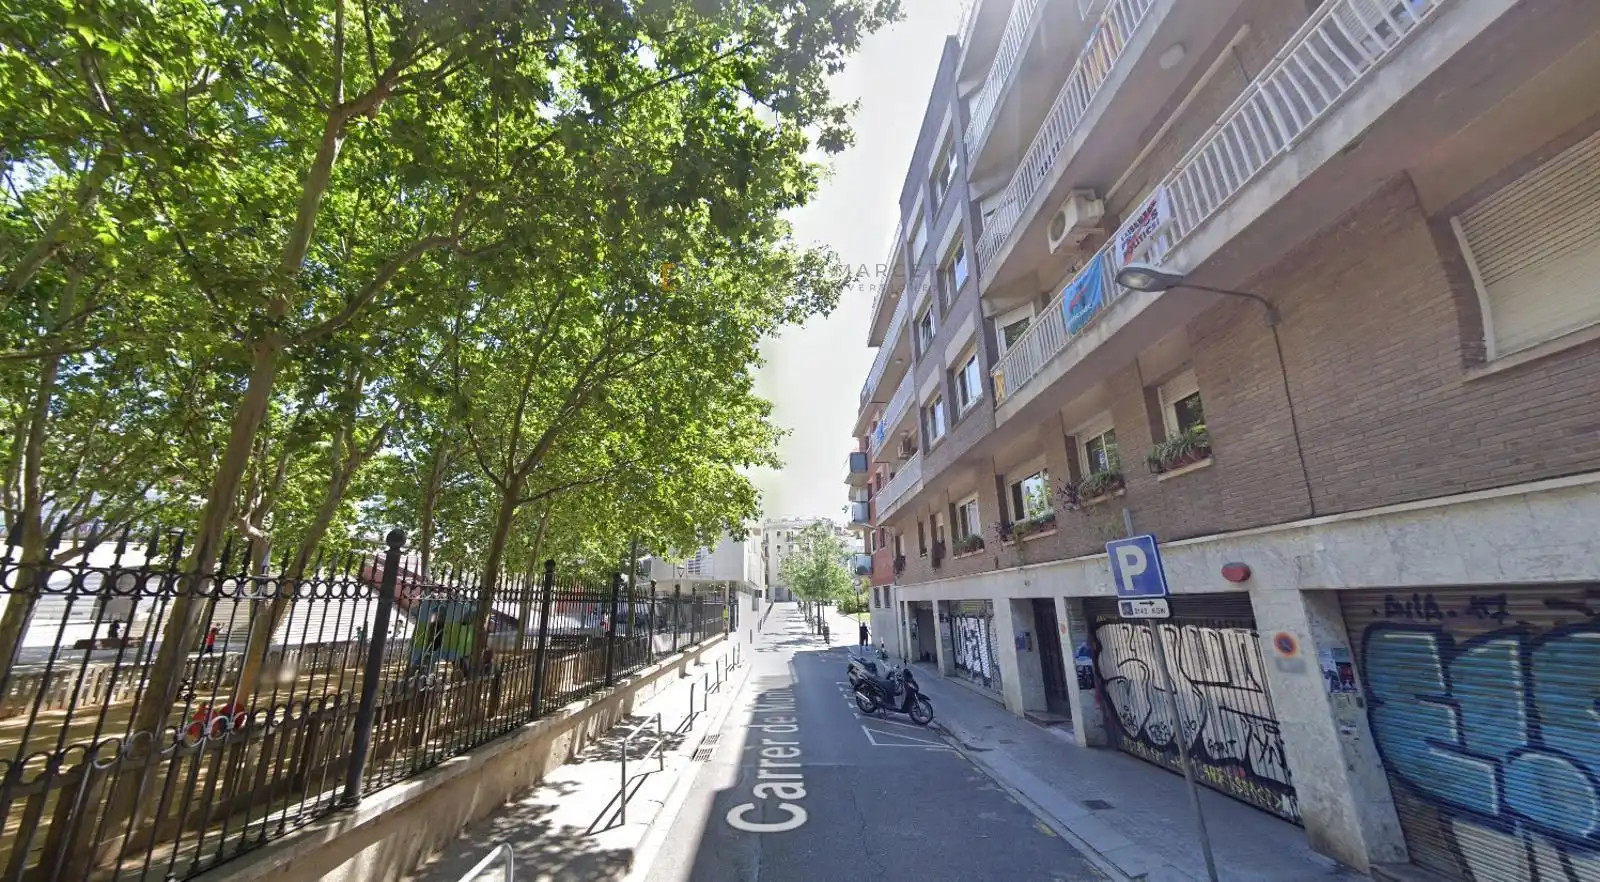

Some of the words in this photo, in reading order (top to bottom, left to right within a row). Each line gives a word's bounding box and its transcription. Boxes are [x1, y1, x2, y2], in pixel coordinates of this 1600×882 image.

[1115, 544, 1147, 591] P
[741, 716, 799, 734] de
[726, 738, 808, 833] Carrer
